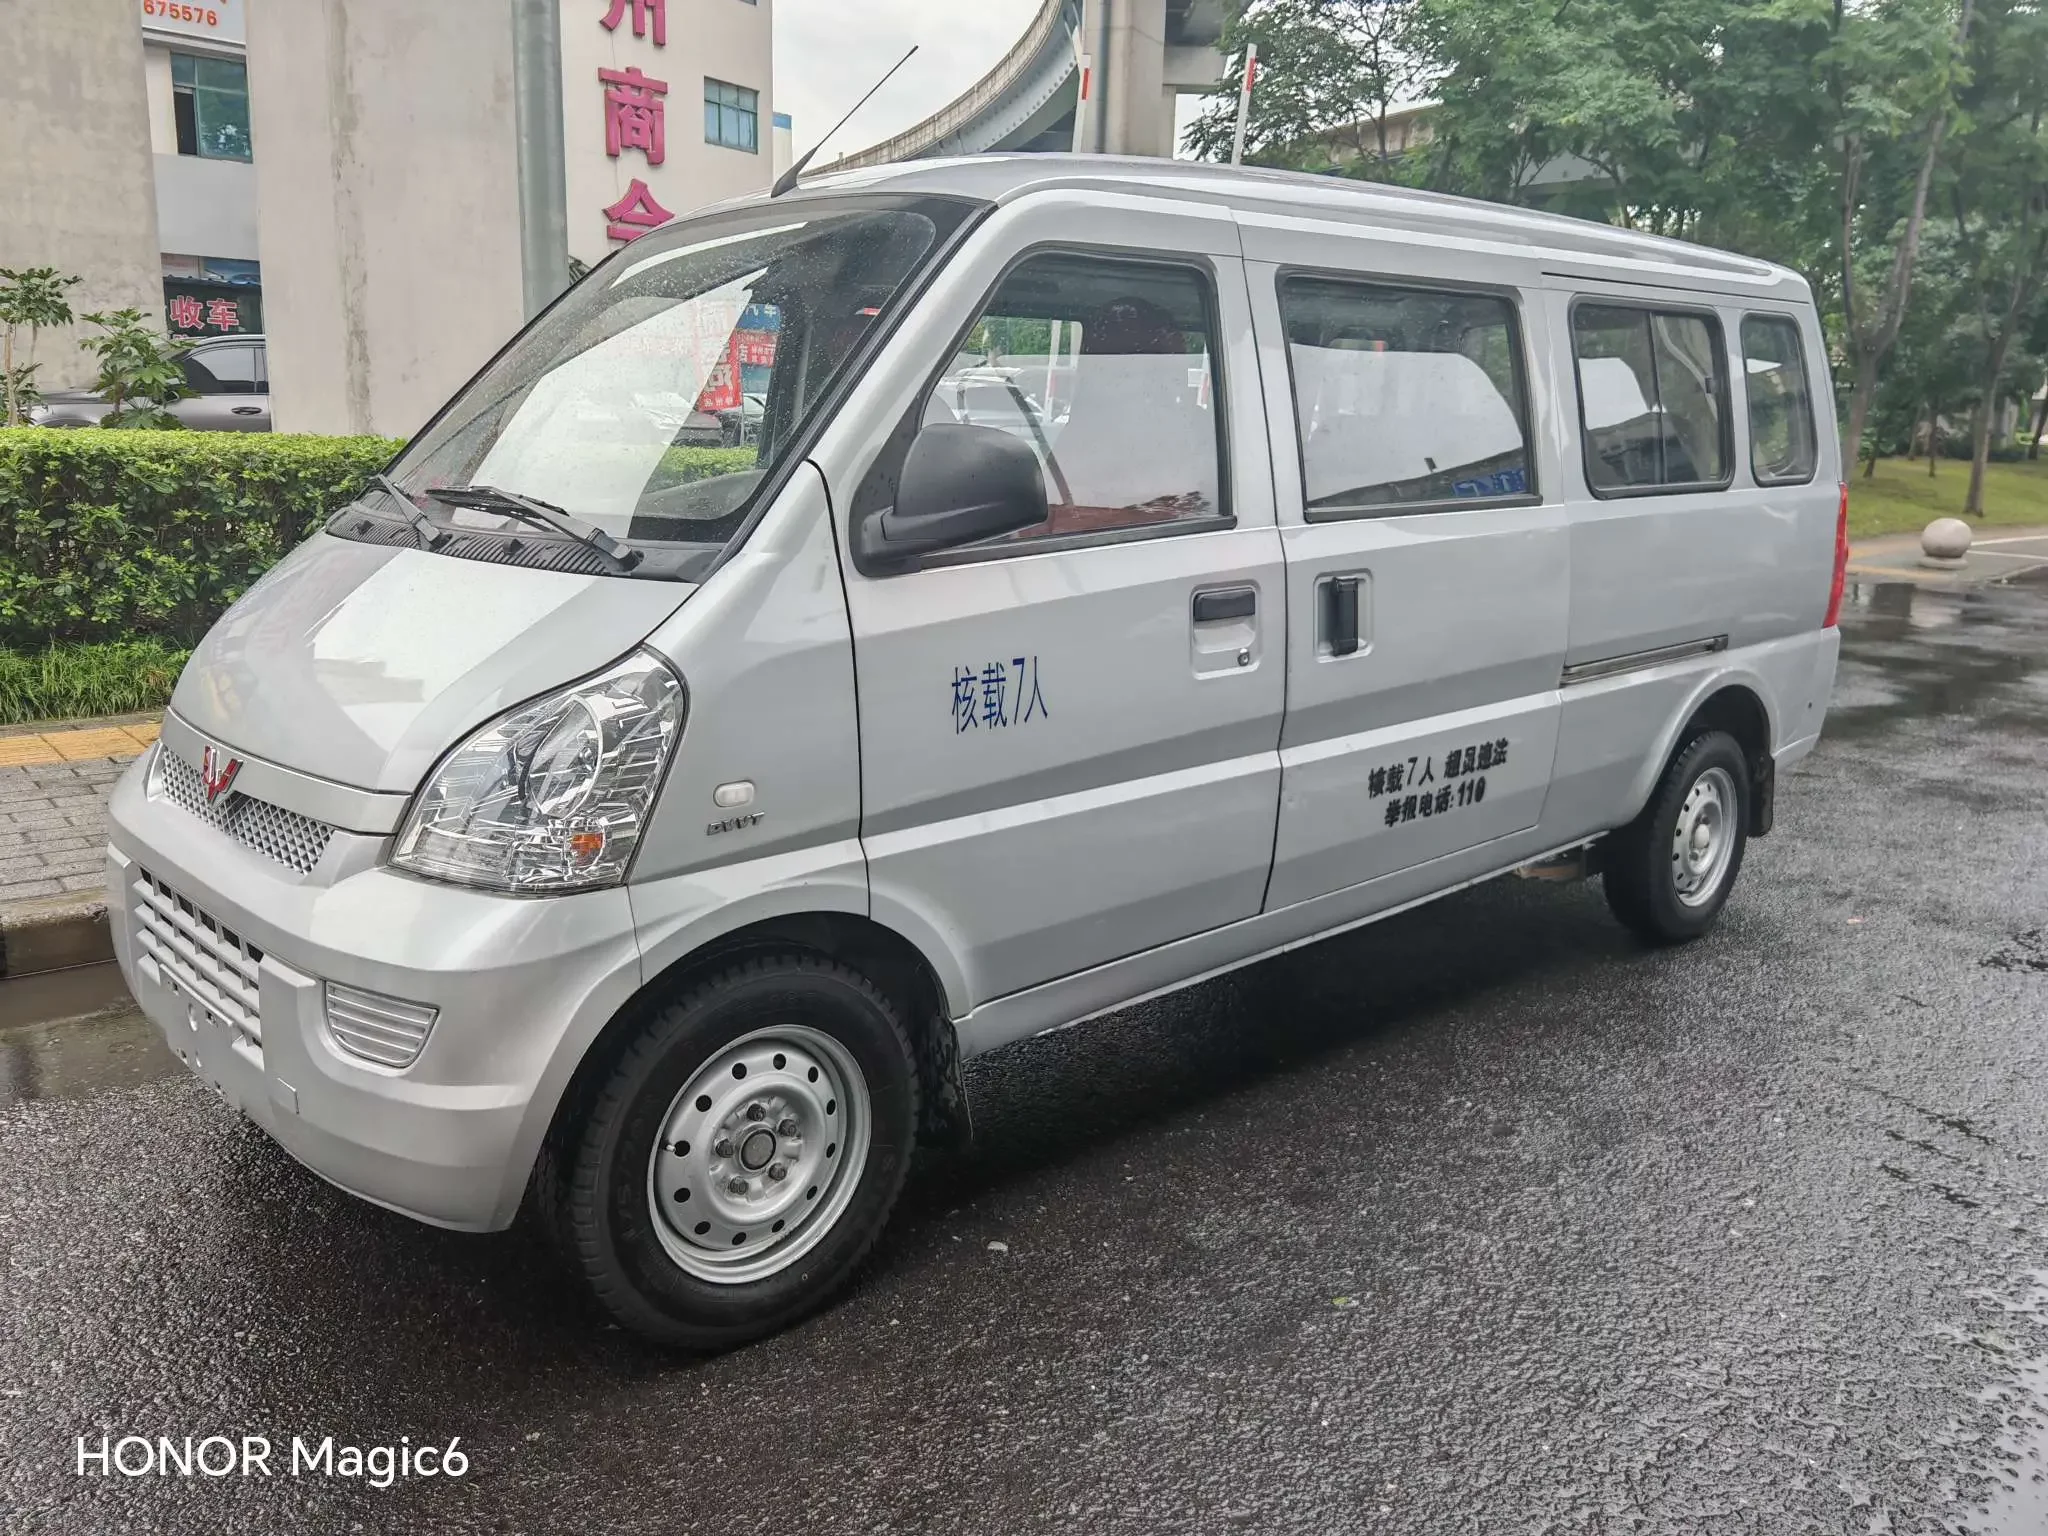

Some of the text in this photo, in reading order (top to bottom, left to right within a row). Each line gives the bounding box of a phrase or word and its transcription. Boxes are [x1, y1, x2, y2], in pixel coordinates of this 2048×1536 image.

[169, 295, 239, 332] 收车
[951, 655, 1048, 735] 核载7人
[1368, 756, 1435, 799] 核载7人
